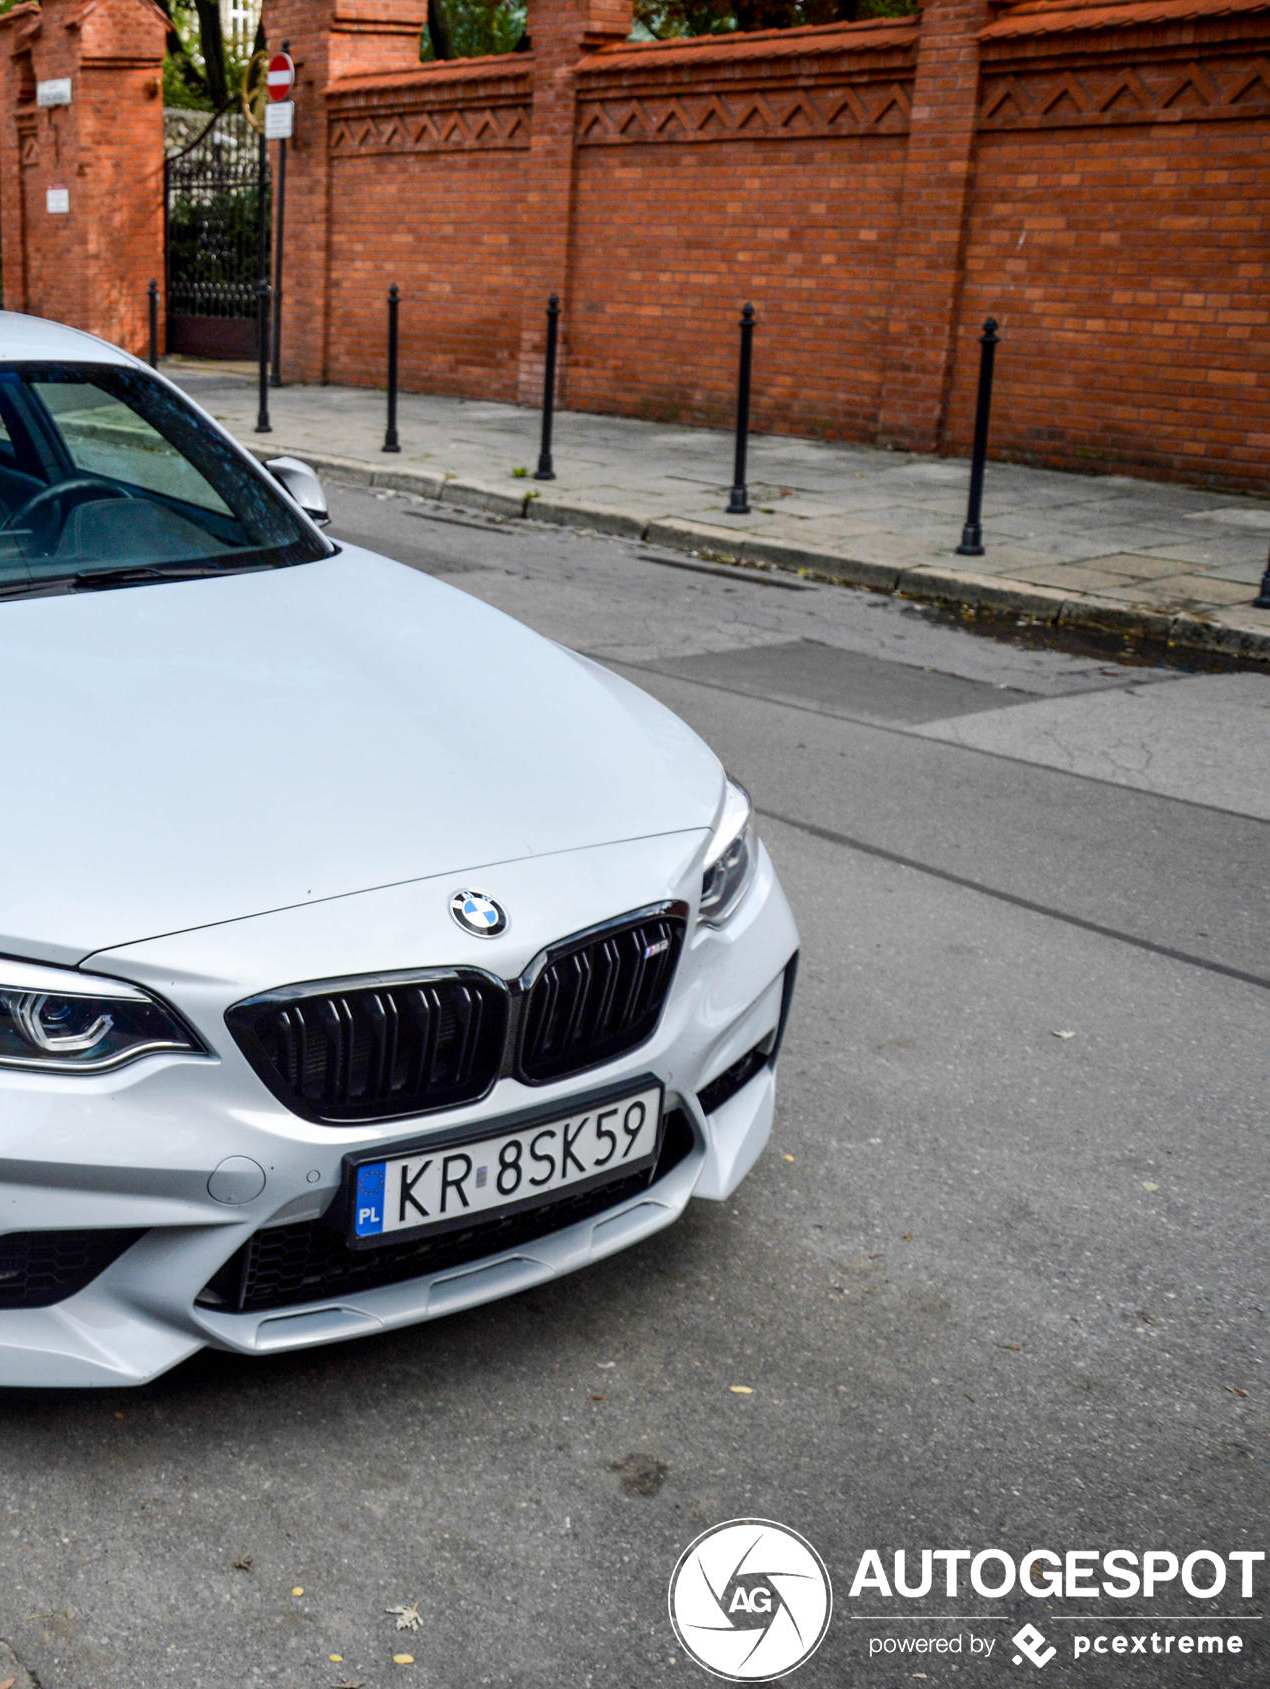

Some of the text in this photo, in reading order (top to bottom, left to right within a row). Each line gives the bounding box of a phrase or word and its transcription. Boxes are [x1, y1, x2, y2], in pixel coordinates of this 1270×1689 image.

[399, 1101, 647, 1222] KR 8SK59
[359, 1207, 380, 1226] PL
